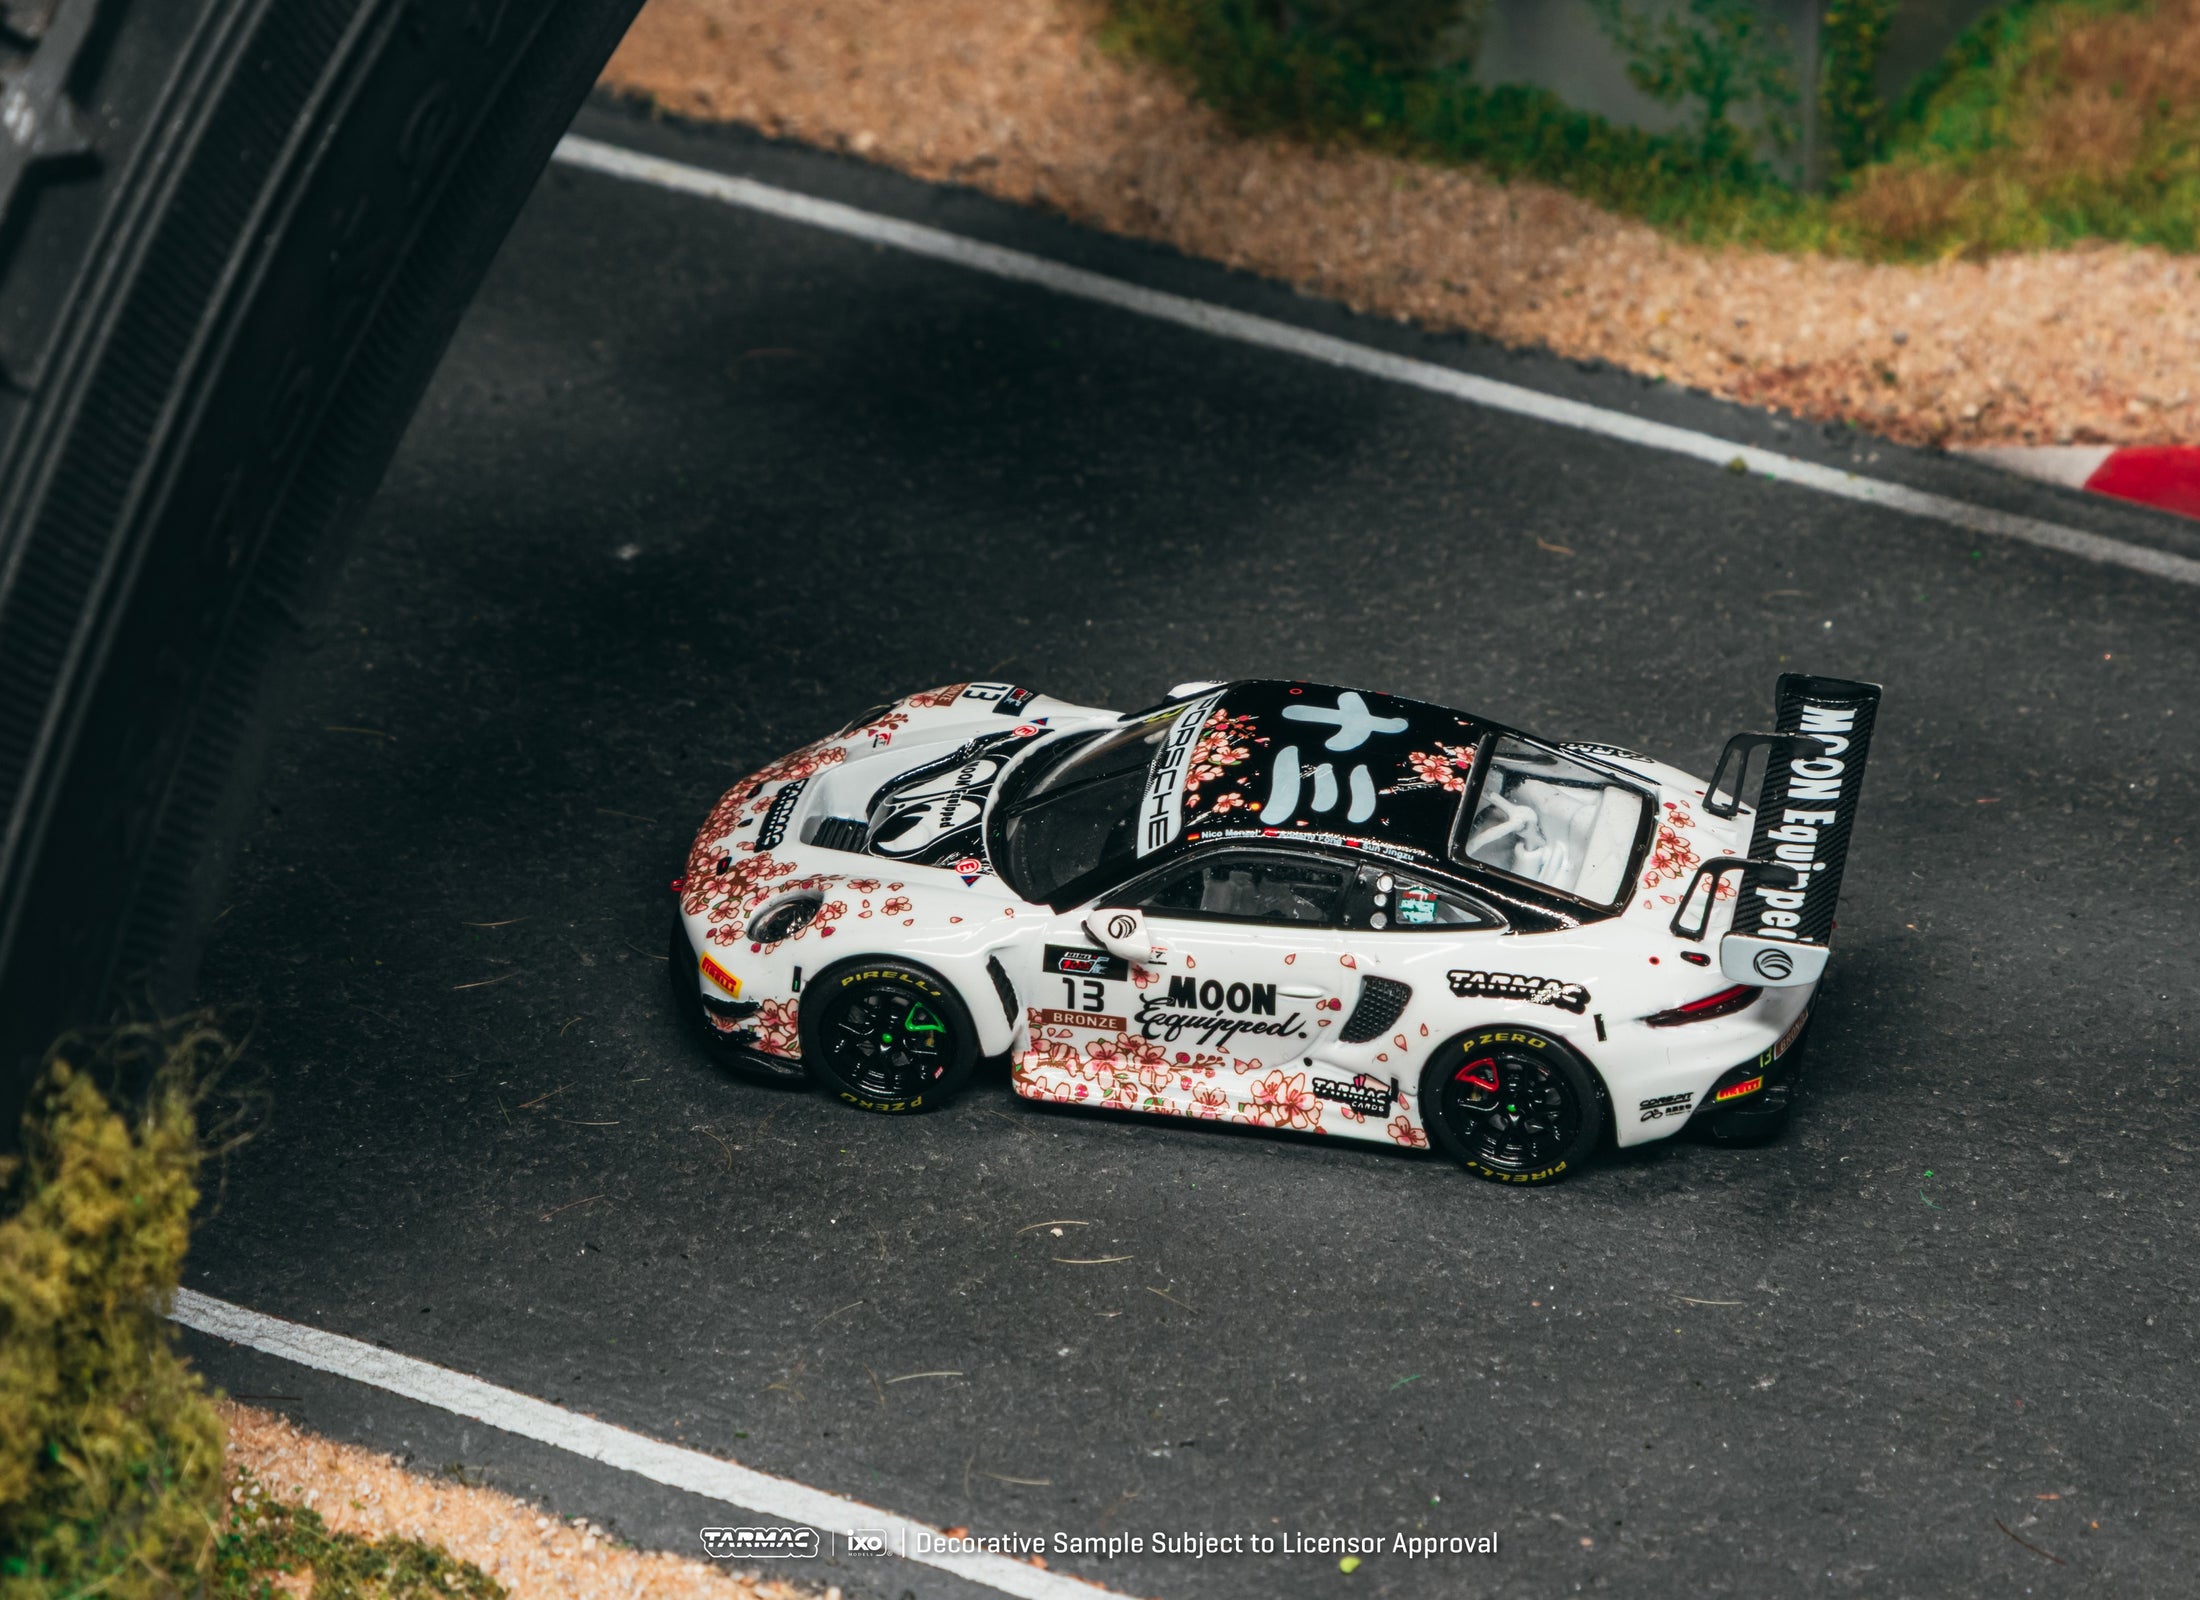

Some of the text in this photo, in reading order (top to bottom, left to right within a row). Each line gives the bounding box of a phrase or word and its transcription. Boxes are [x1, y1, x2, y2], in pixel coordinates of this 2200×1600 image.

[1147, 695, 1220, 851] PORSCHE
[1756, 808, 1836, 942] Equipe
[841, 970, 942, 997] PIRELLI
[1062, 977, 1105, 1013] 13
[1167, 975, 1277, 1016] MOON
[1450, 971, 1584, 1004] TARMAC
[1052, 1012, 1119, 1030] BRONZE
[1313, 1079, 1387, 1106] TARMAC
[1351, 1100, 1385, 1113] CARDS
[1466, 1160, 1568, 1183] PIRELLI
